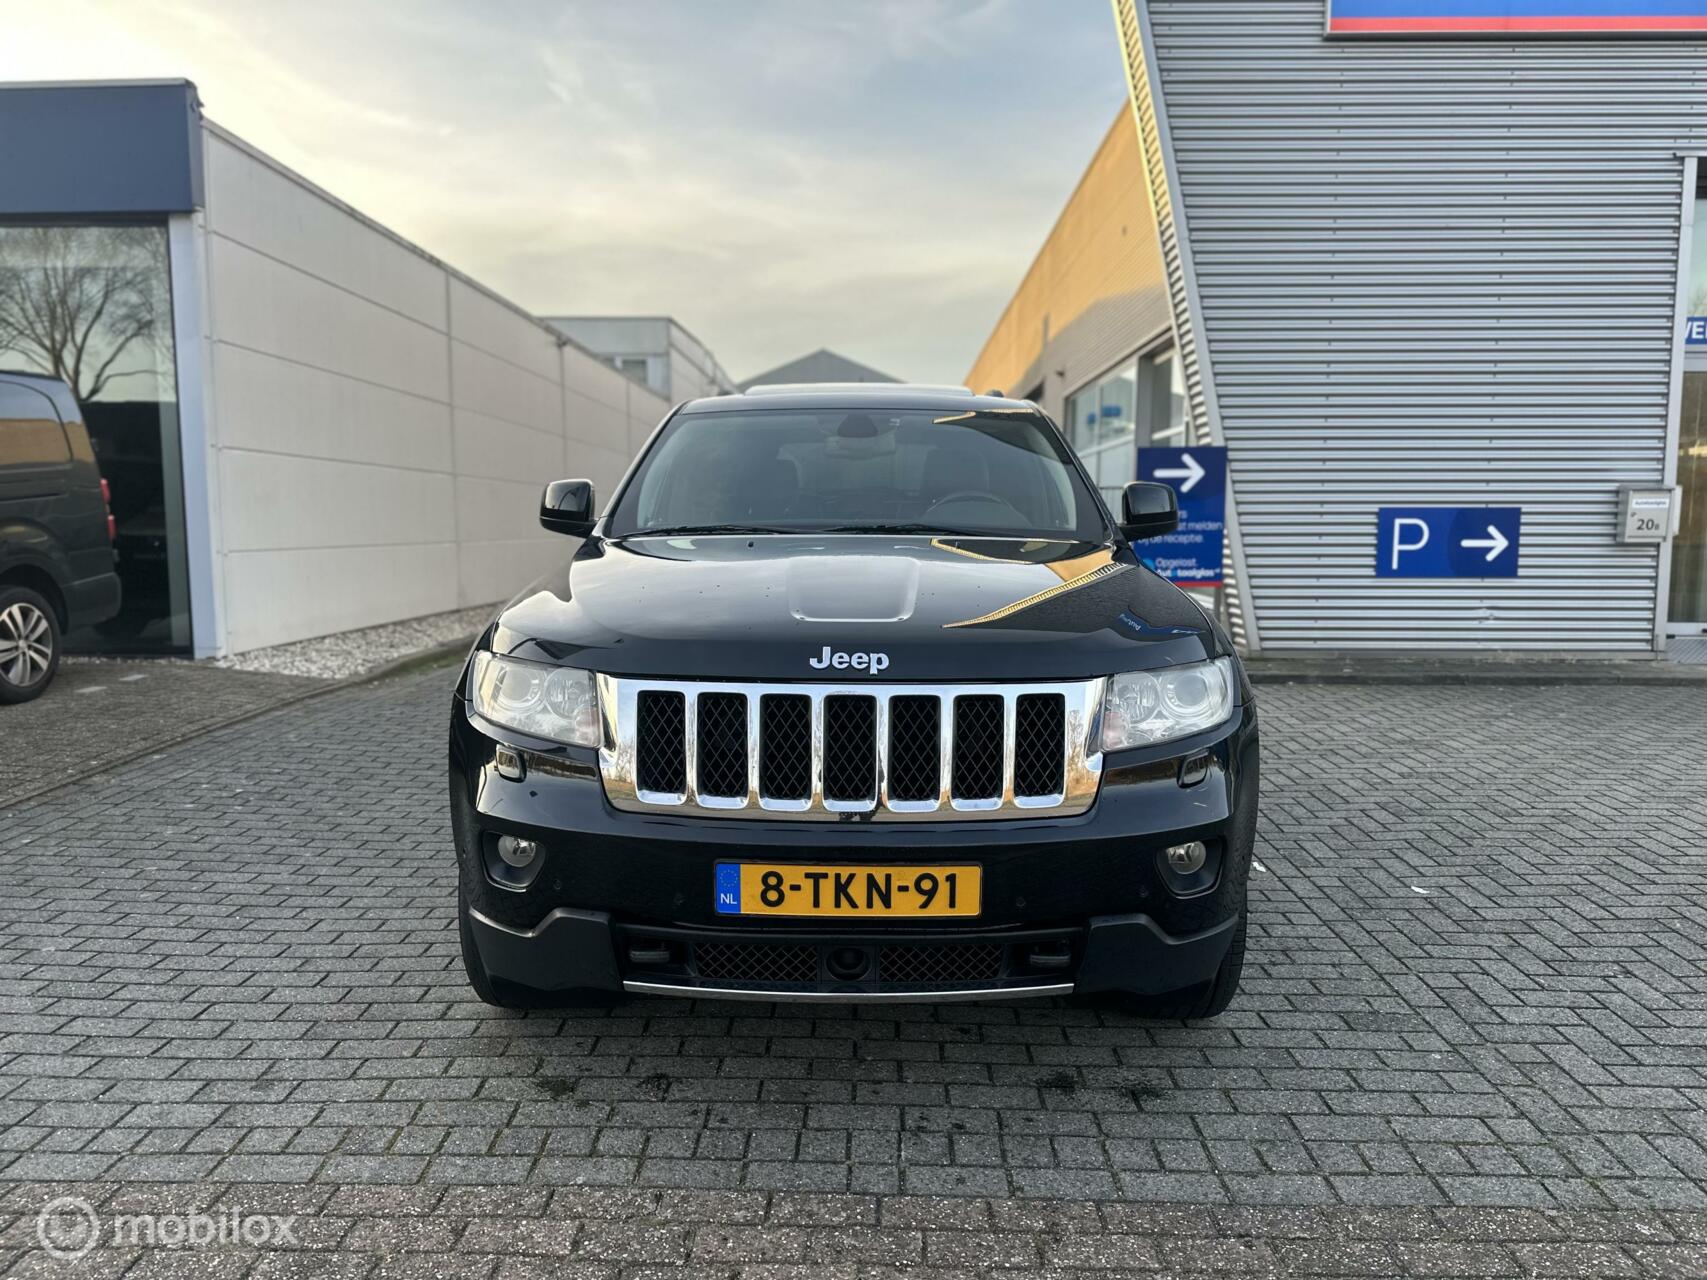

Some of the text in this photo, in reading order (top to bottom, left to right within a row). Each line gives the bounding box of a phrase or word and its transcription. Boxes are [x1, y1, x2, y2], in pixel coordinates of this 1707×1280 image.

[1391, 518, 1430, 570] P
[809, 646, 890, 675] Jeep
[720, 892, 738, 905] NL
[760, 870, 958, 909] 8-TKN-91
